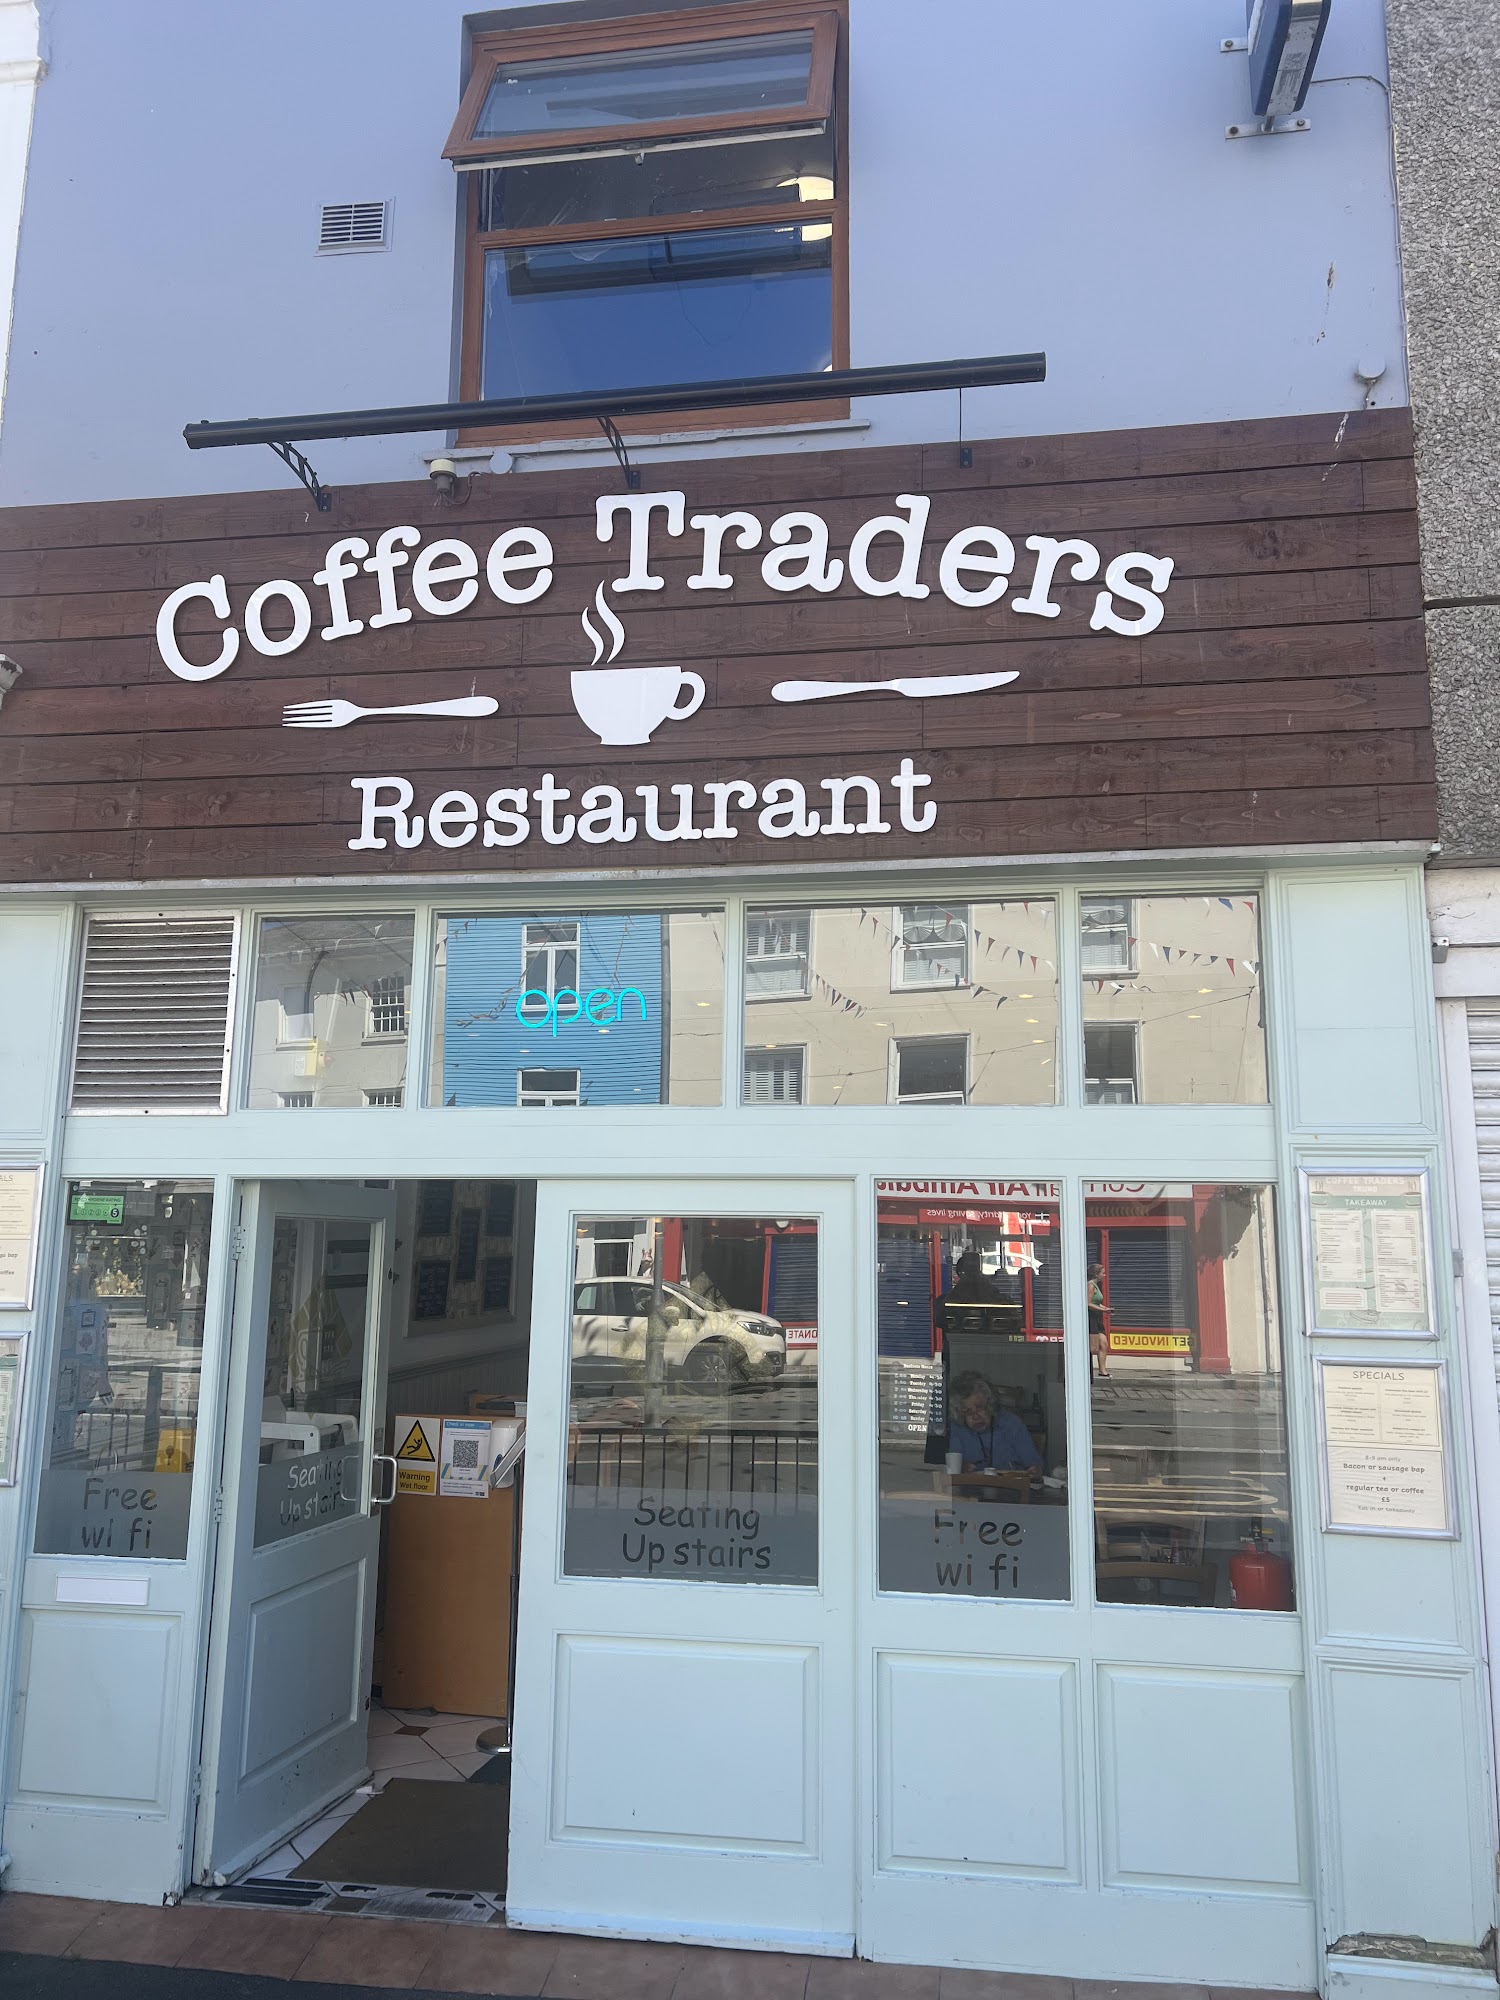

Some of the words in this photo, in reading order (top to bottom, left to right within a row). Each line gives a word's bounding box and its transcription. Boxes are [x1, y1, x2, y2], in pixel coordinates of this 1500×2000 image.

[155, 524, 554, 684] Coffee
[595, 490, 1176, 637] Traders
[346, 757, 938, 850] Restaurant
[515, 986, 648, 1037] open
[1345, 1198, 1387, 1206] TAKEAWAY
[111, 1209, 118, 1217] 5
[1352, 1370, 1405, 1381] SPECIALS
[908, 1424, 927, 1432] OPEN
[1343, 1462, 1366, 1470] Bacon
[1378, 1465, 1409, 1473] sausage
[1411, 1466, 1425, 1474] bap
[399, 1471, 431, 1484] Warning
[399, 1481, 412, 1489] Wet
[413, 1481, 429, 1490] floor
[1346, 1484, 1374, 1492] regular
[83, 1477, 158, 1511] Free
[634, 1496, 761, 1541] Seating
[934, 1508, 1023, 1547] Free
[988, 1553, 1019, 1591] fi
